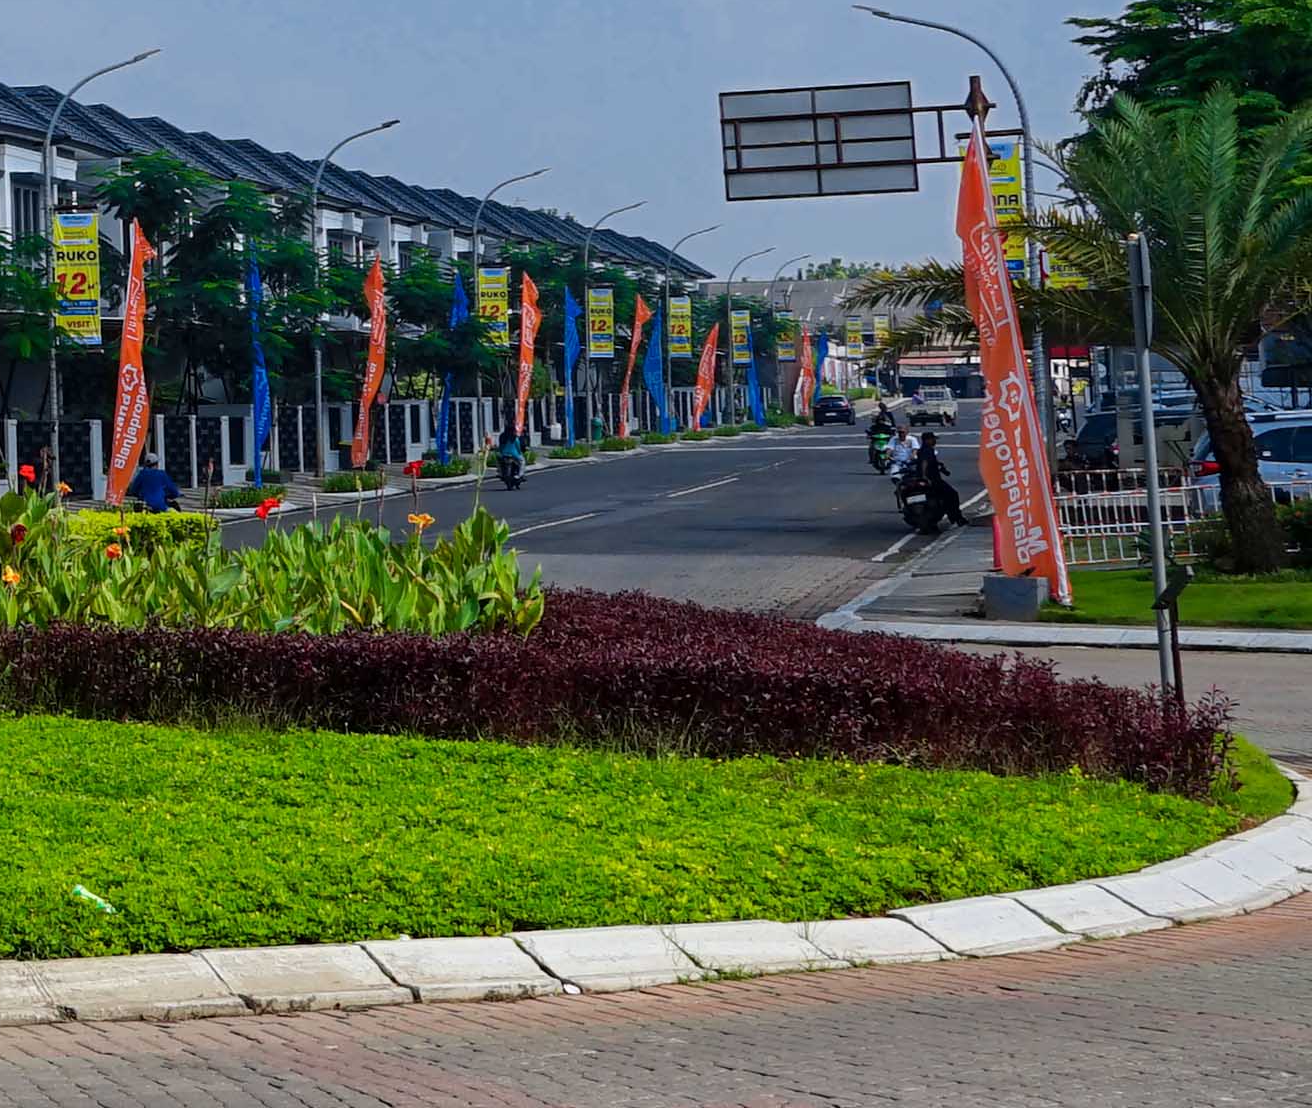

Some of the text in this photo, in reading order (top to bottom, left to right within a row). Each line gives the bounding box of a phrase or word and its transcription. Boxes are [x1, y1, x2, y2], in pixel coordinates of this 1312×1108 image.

[56, 251, 97, 262] RUKO
[66, 320, 91, 329] VISIT
[114, 366, 148, 470] Blanjaproper
